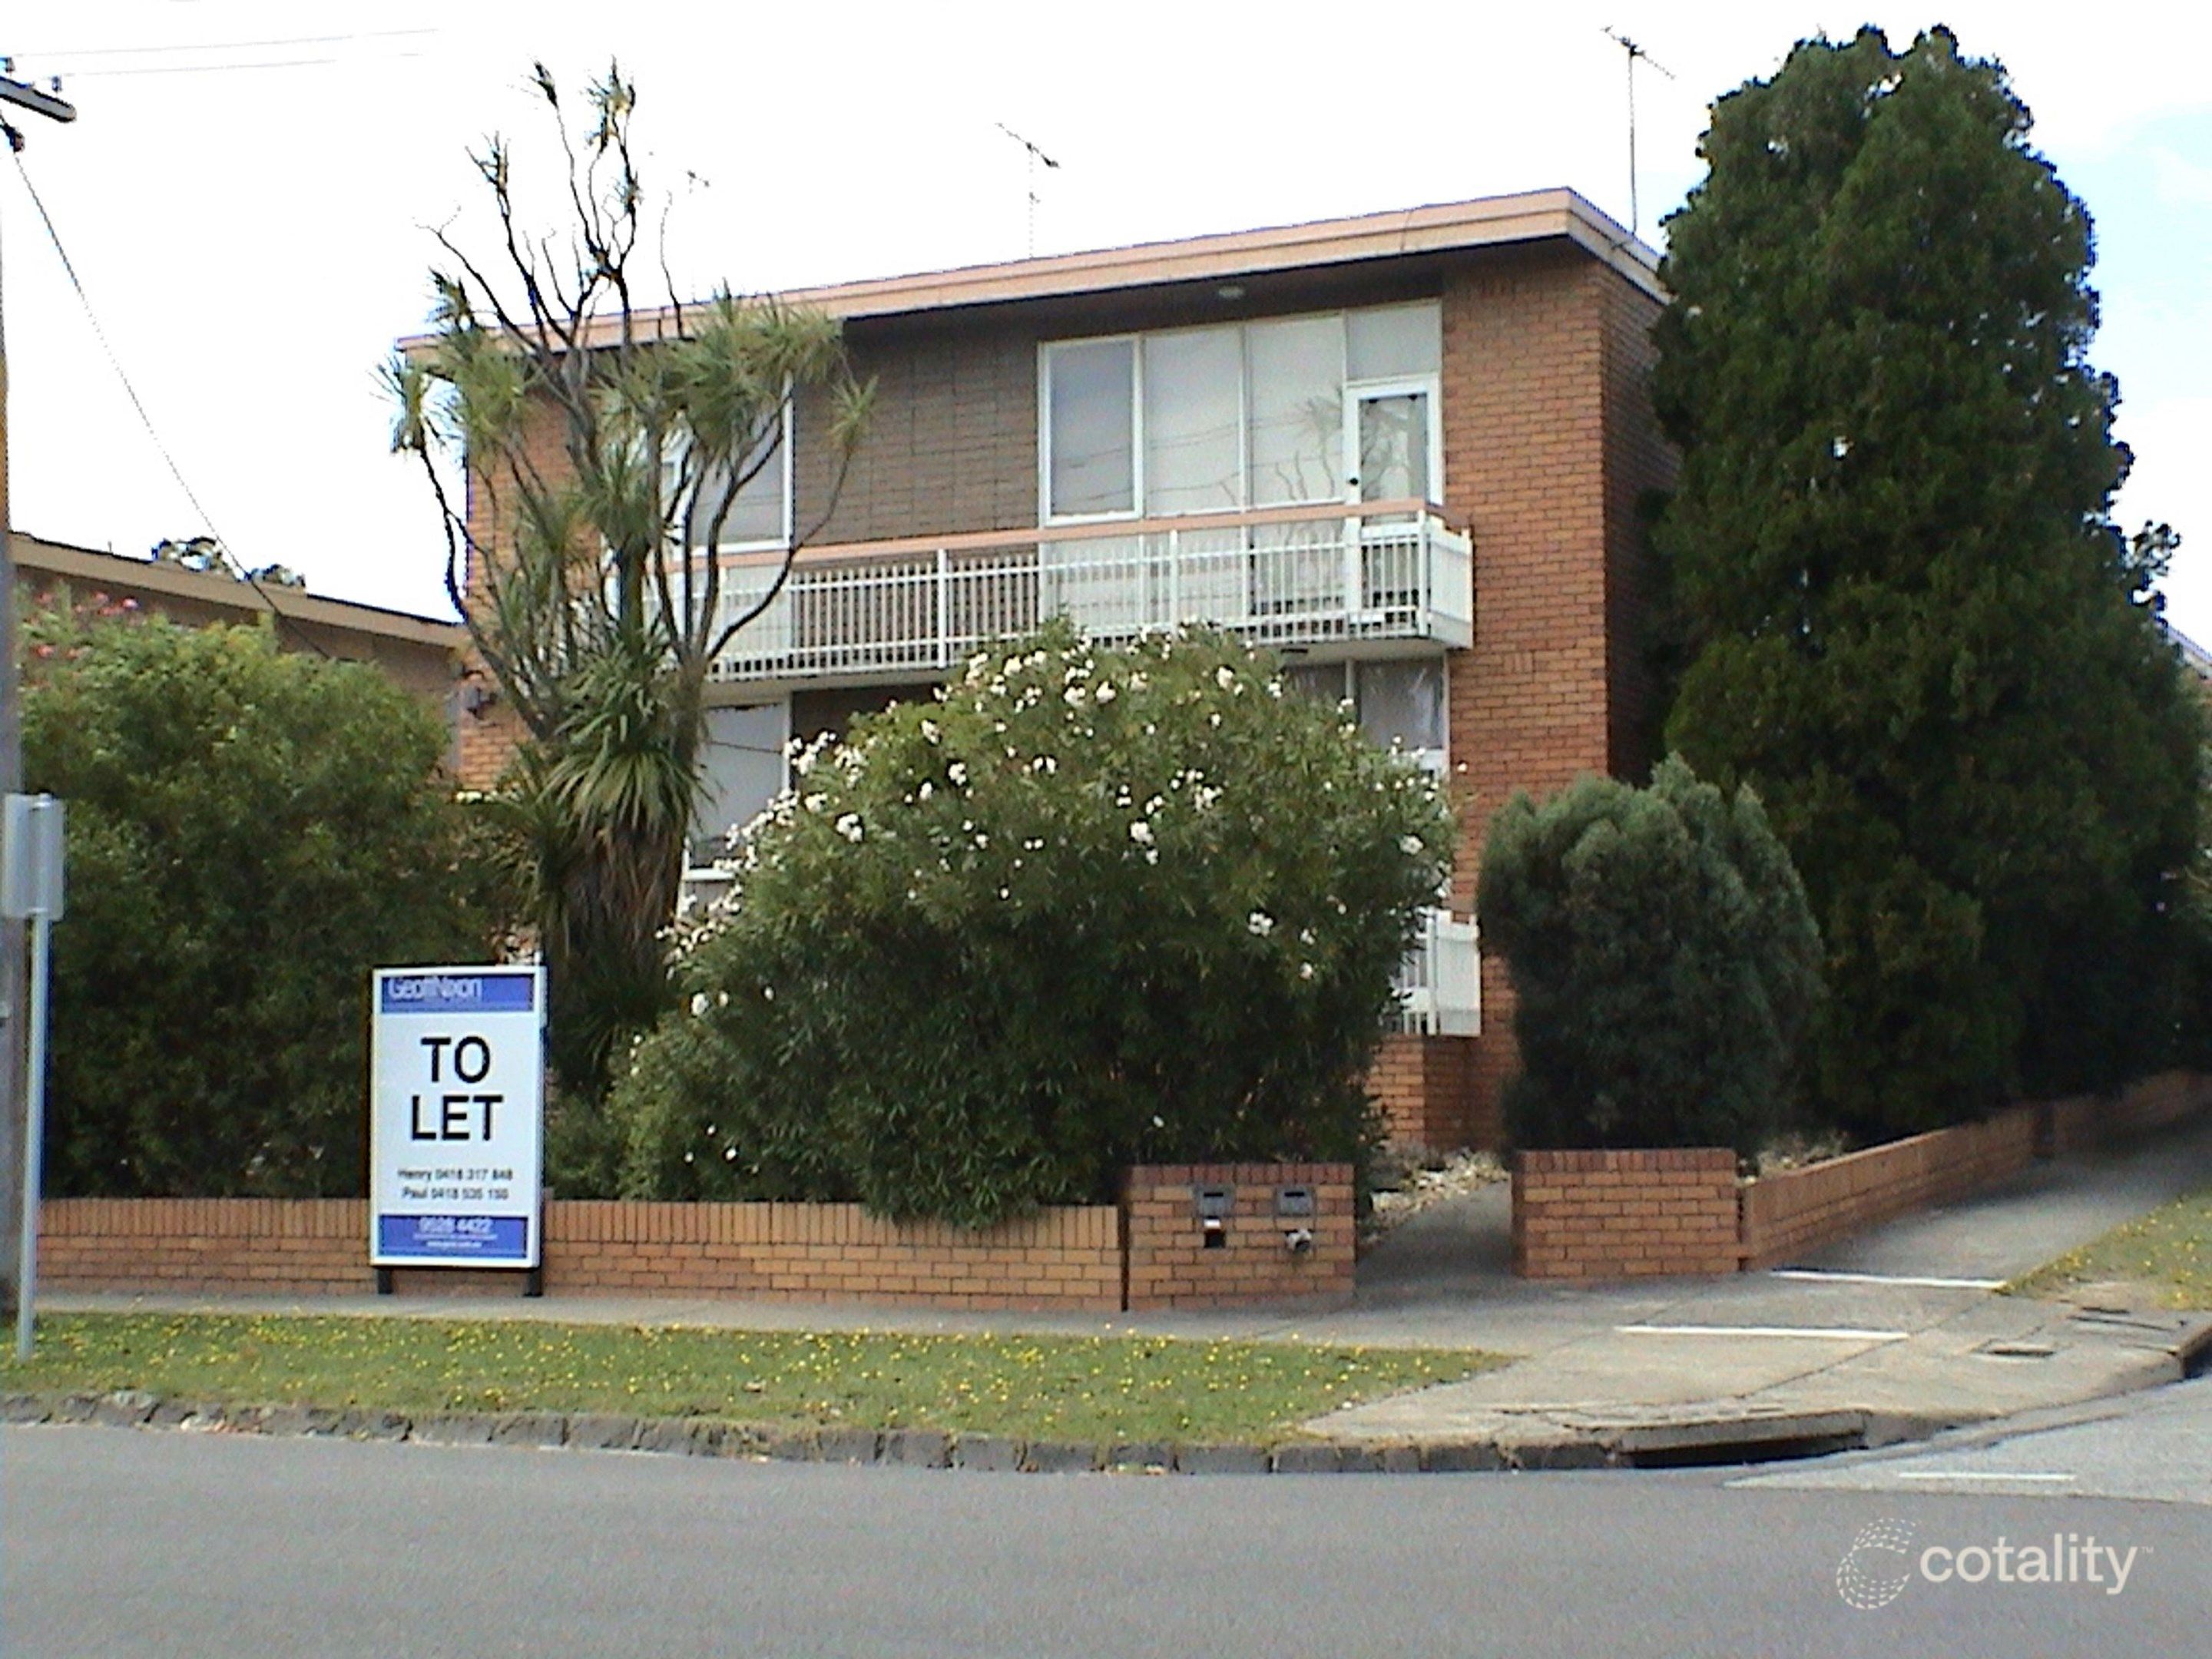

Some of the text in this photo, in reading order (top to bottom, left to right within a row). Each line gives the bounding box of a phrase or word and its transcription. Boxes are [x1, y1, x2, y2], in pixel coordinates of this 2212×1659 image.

[421, 1036, 491, 1084] TO
[412, 1094, 504, 1141] LET
[398, 1169, 432, 1181] Henry
[466, 1168, 488, 1180] 317
[402, 1187, 428, 1199] Paul
